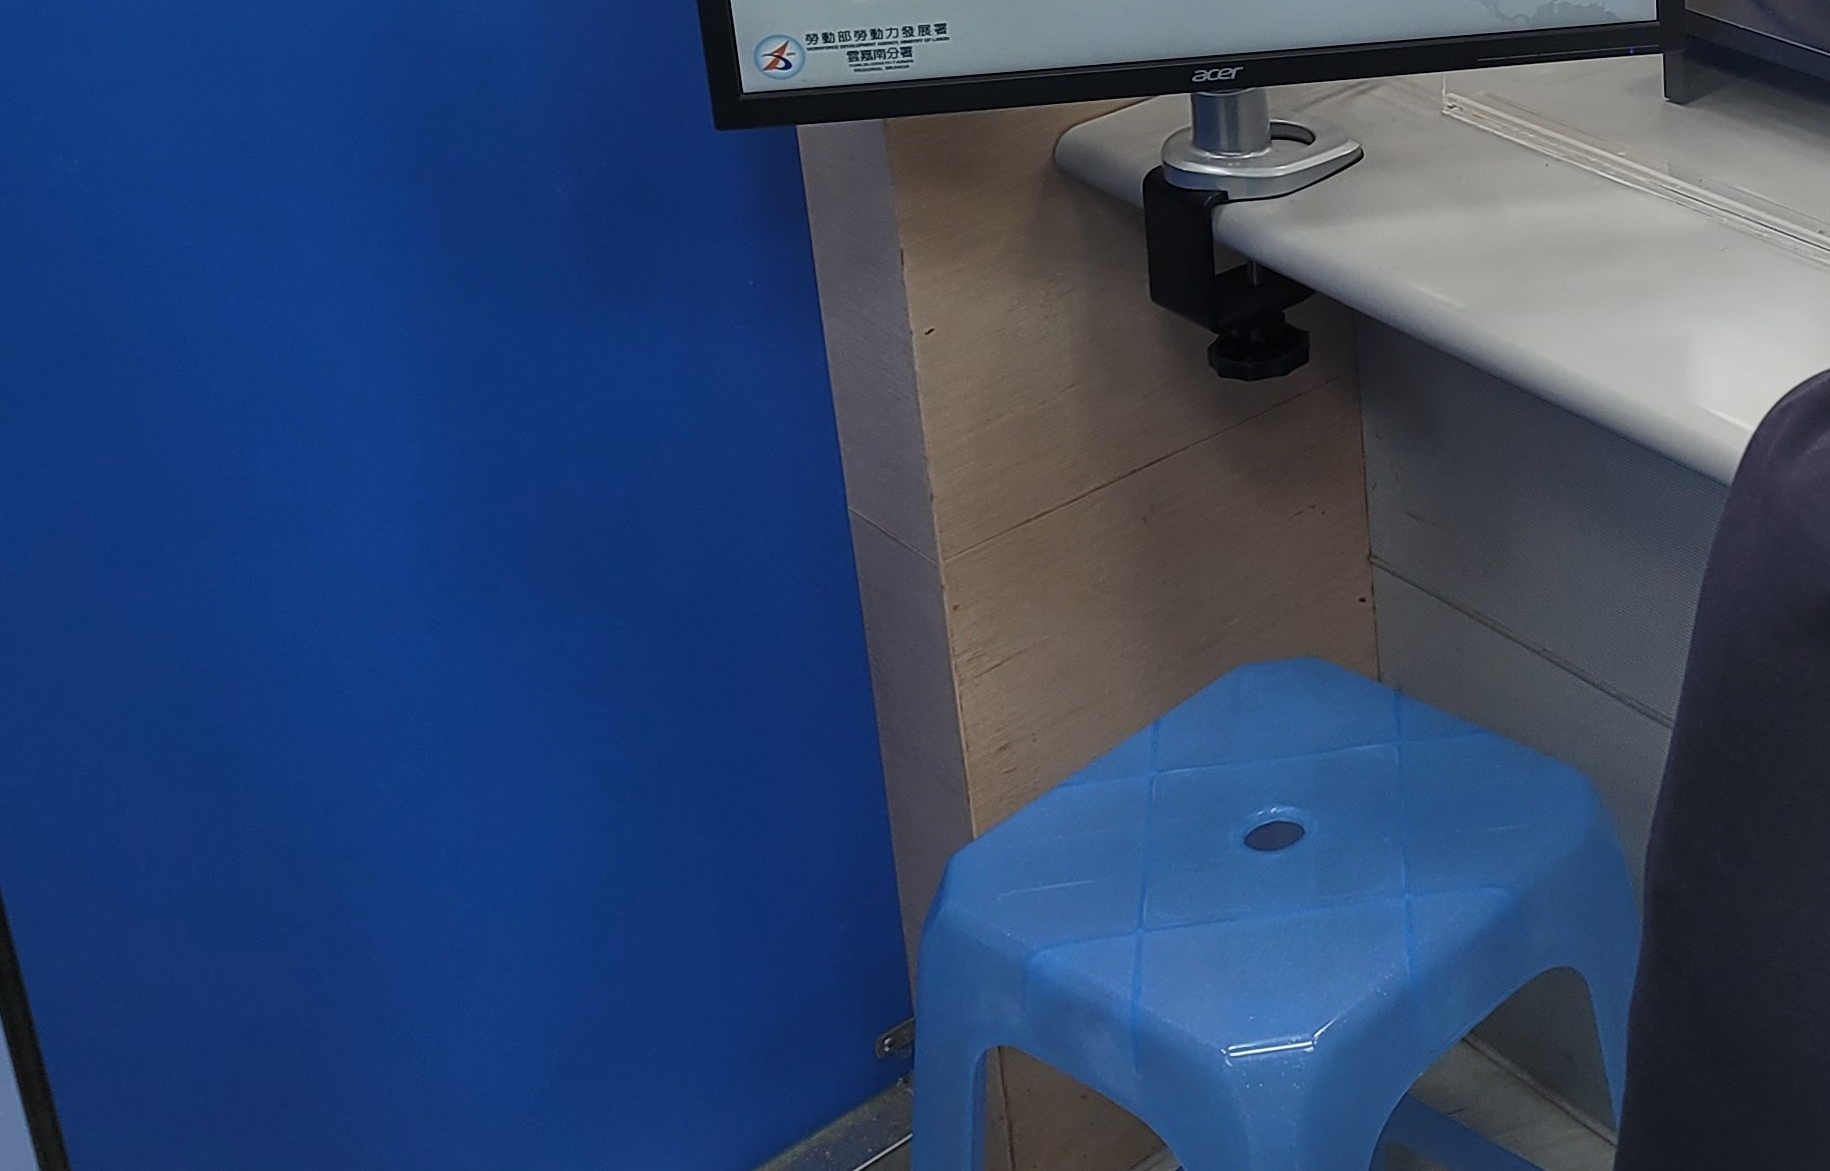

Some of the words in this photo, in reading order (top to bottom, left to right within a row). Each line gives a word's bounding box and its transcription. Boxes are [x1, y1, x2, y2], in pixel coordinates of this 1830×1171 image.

[805, 23, 947, 46] 勞動部勞動力發展署
[1191, 66, 1244, 82] acer
